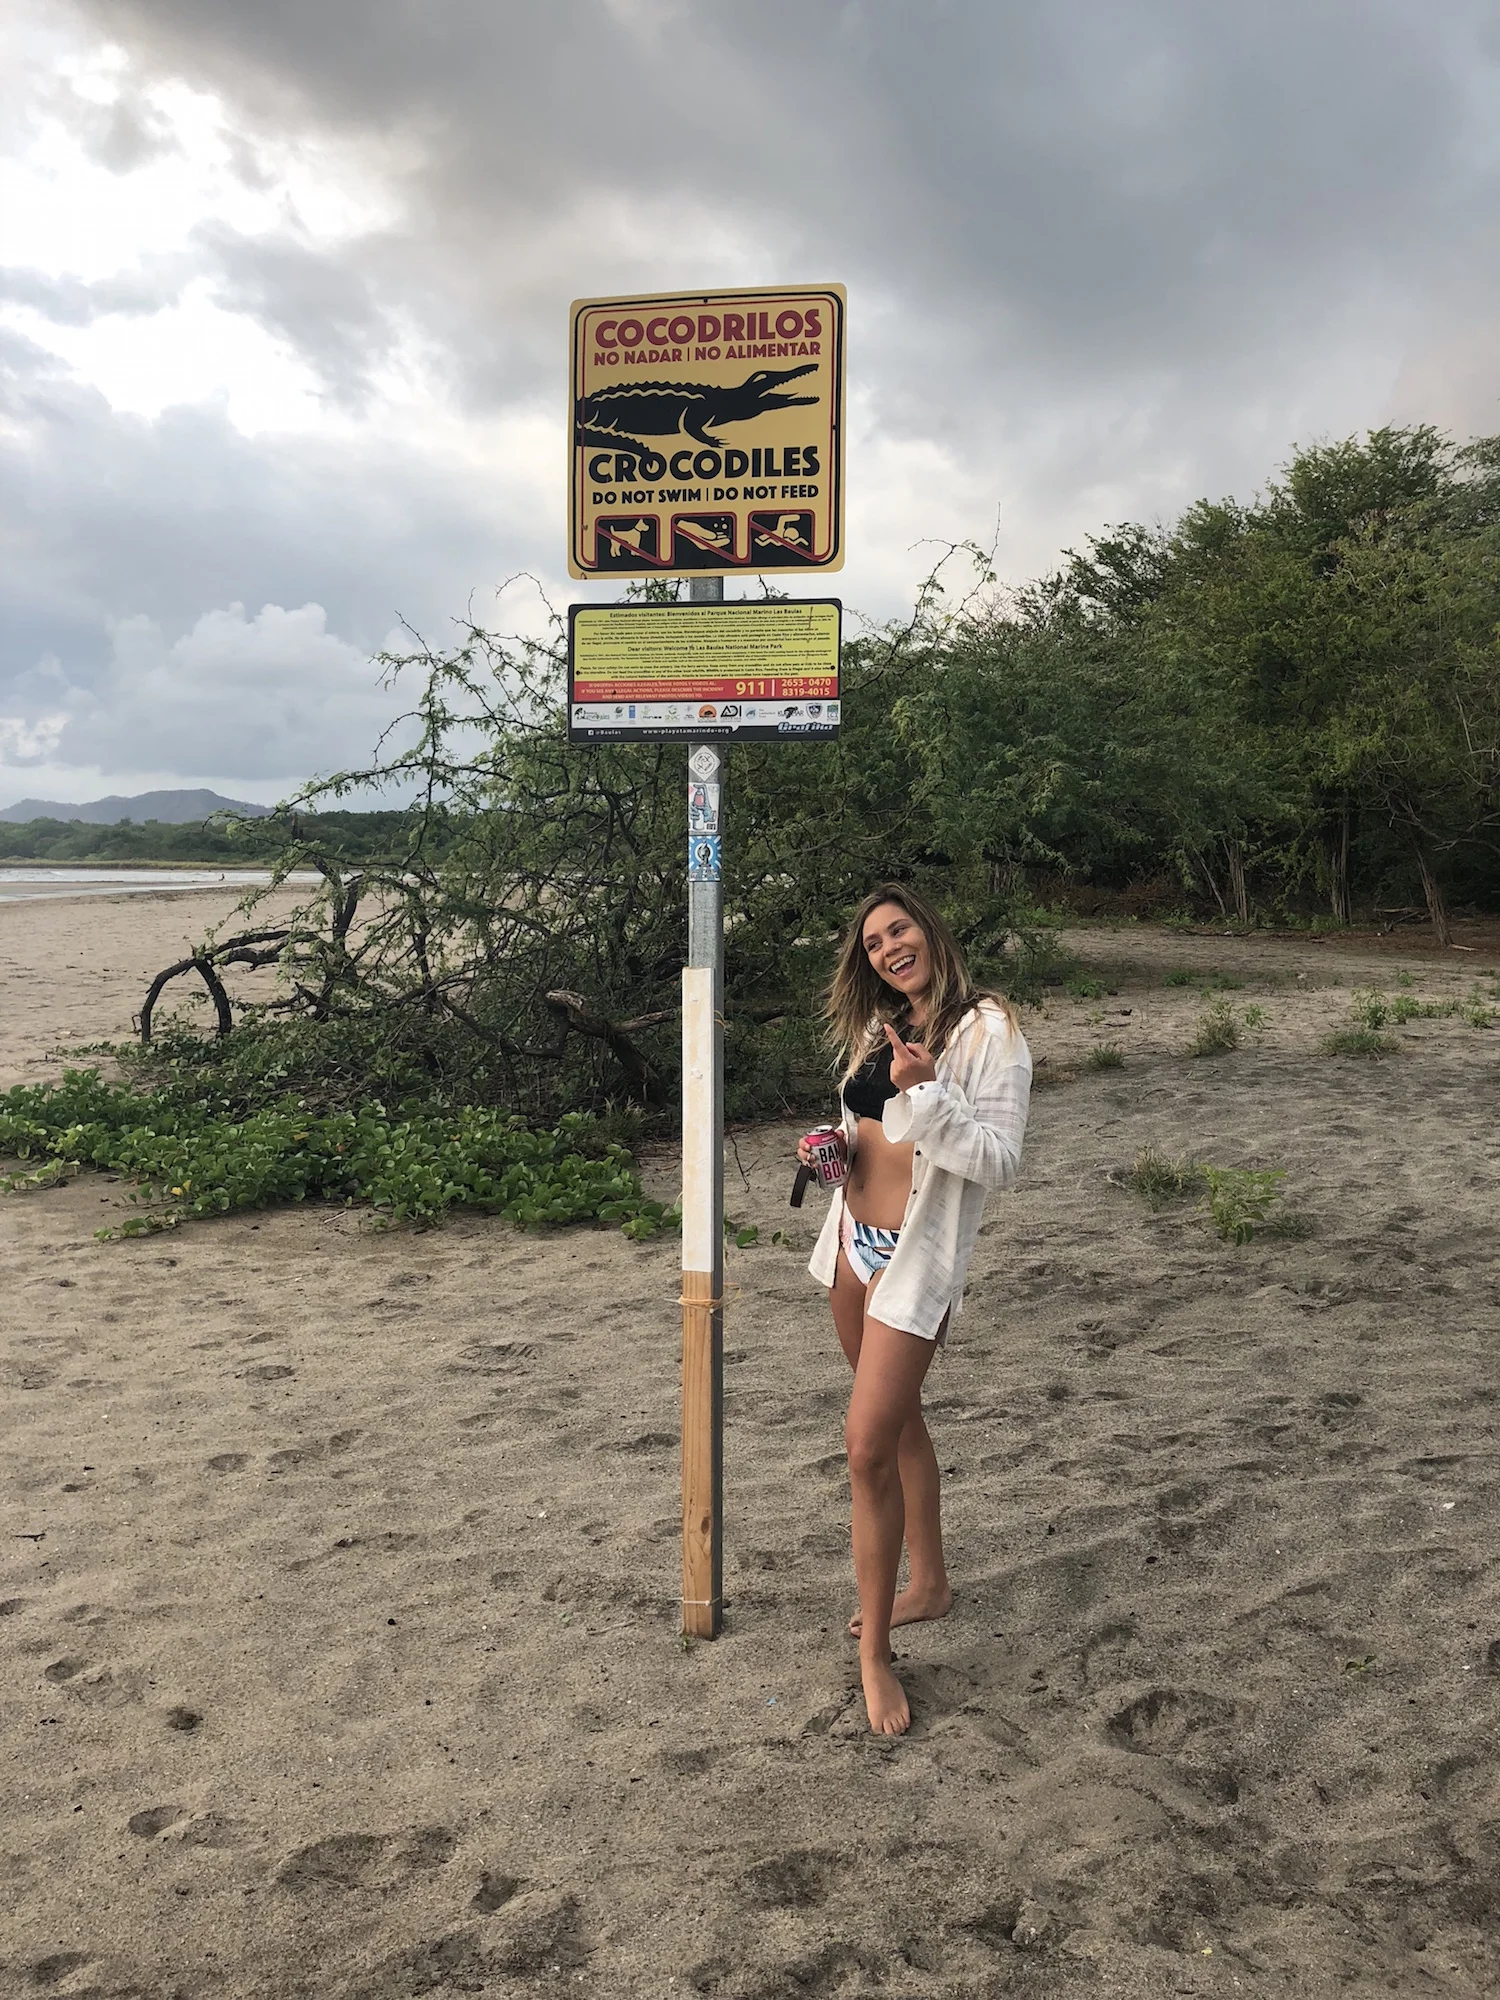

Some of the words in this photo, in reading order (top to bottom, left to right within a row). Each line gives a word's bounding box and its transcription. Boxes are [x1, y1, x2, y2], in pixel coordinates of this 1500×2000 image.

[595, 309, 822, 348] COCODRILOS
[594, 352, 619, 366] NO
[624, 349, 682, 364] NADAR
[695, 347, 720, 360] NO
[725, 342, 820, 359] ALIMENTAR
[588, 446, 820, 484] CROCODILES
[592, 492, 617, 504] DO
[622, 490, 654, 504] NOT
[658, 488, 700, 502] SWIM
[714, 487, 738, 501] DO
[744, 486, 777, 500] NOT
[782, 485, 818, 498] FEED
[736, 681, 765, 695] 911
[782, 687, 830, 696] 8319-4015
[808, 678, 831, 686] 0470
